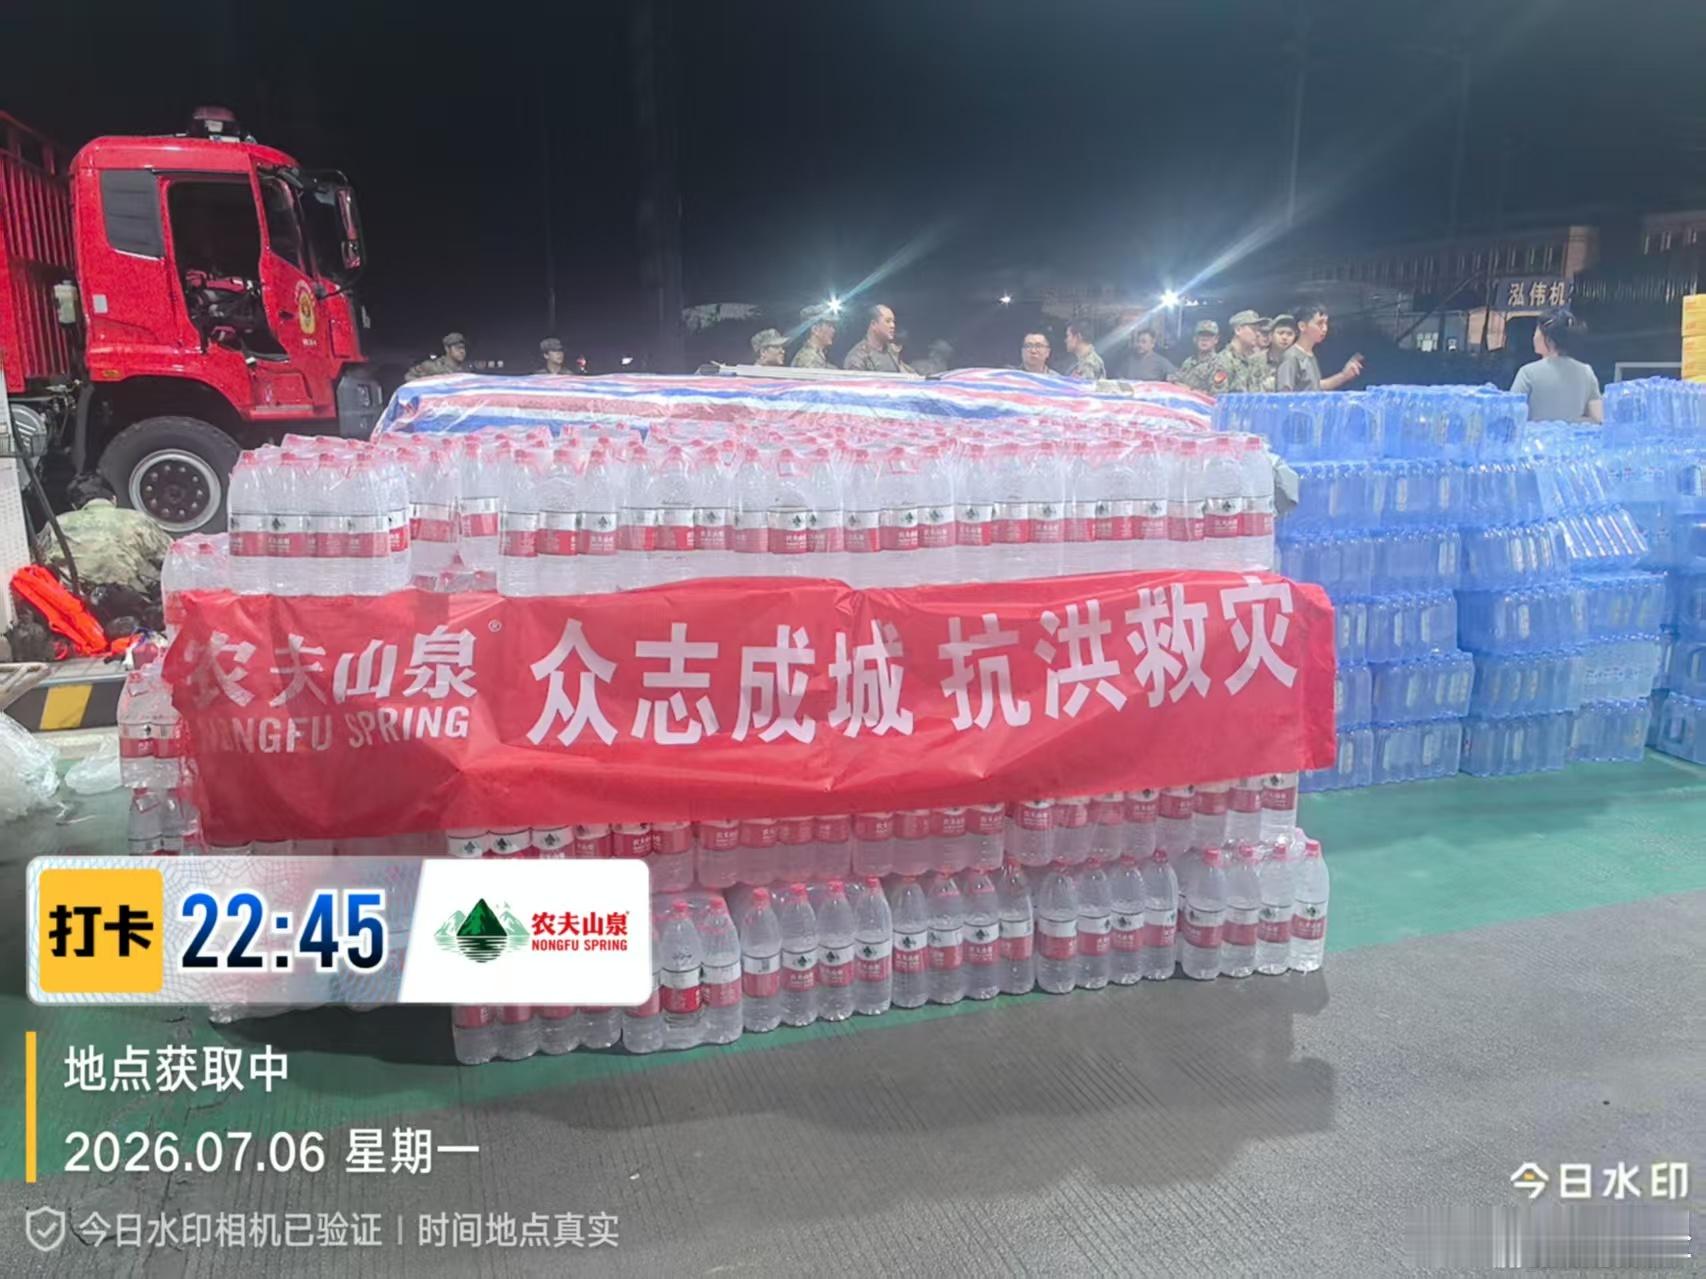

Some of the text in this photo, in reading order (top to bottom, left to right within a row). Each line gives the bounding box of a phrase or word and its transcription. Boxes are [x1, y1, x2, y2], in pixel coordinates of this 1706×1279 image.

[183, 624, 478, 708] 农夫山泉
[527, 576, 1297, 746] 众志成城 抗洪救灾
[345, 705, 471, 749] SPRING
